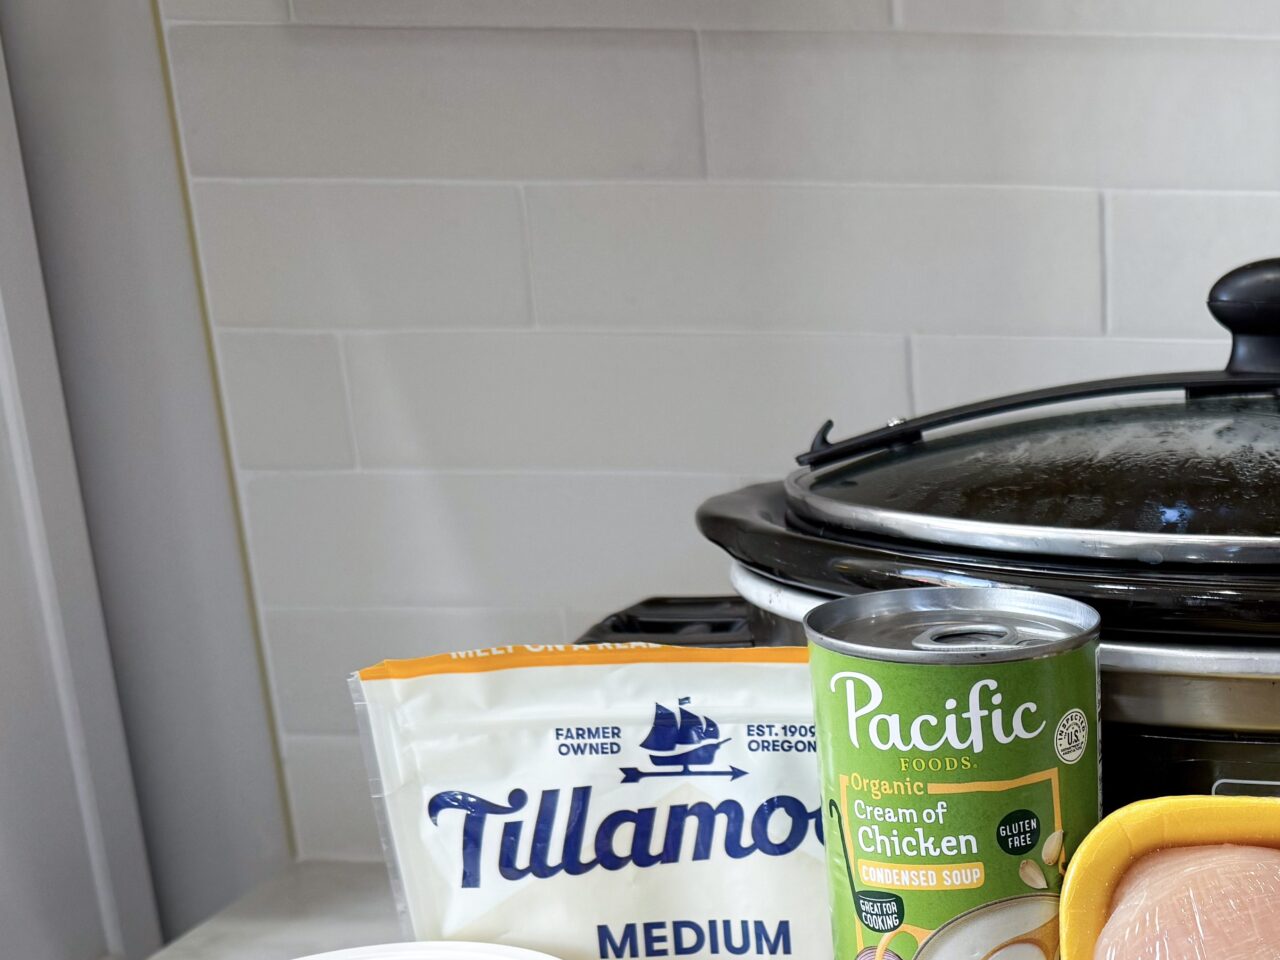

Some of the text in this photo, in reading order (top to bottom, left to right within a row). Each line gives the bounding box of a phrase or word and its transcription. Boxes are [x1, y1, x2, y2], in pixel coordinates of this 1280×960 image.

[830, 671, 1046, 753] Pacific
[555, 726, 621, 741] FARMER
[747, 725, 816, 737] EST. 1909
[558, 742, 621, 756] OWNED
[748, 740, 817, 752] OREGON
[900, 756, 971, 772] FOODS
[851, 772, 925, 799] Organic
[854, 800, 947, 824] Cream of
[428, 785, 825, 889] Tillamo
[999, 818, 1037, 837] GLUTEN
[857, 826, 978, 857] Chicken
[1008, 834, 1032, 849] FREE
[862, 866, 981, 886] CONDENSED SOUP
[860, 900, 898, 915] GREAT FOR
[862, 911, 899, 930] COOKING
[597, 920, 792, 959] MEDIUM
